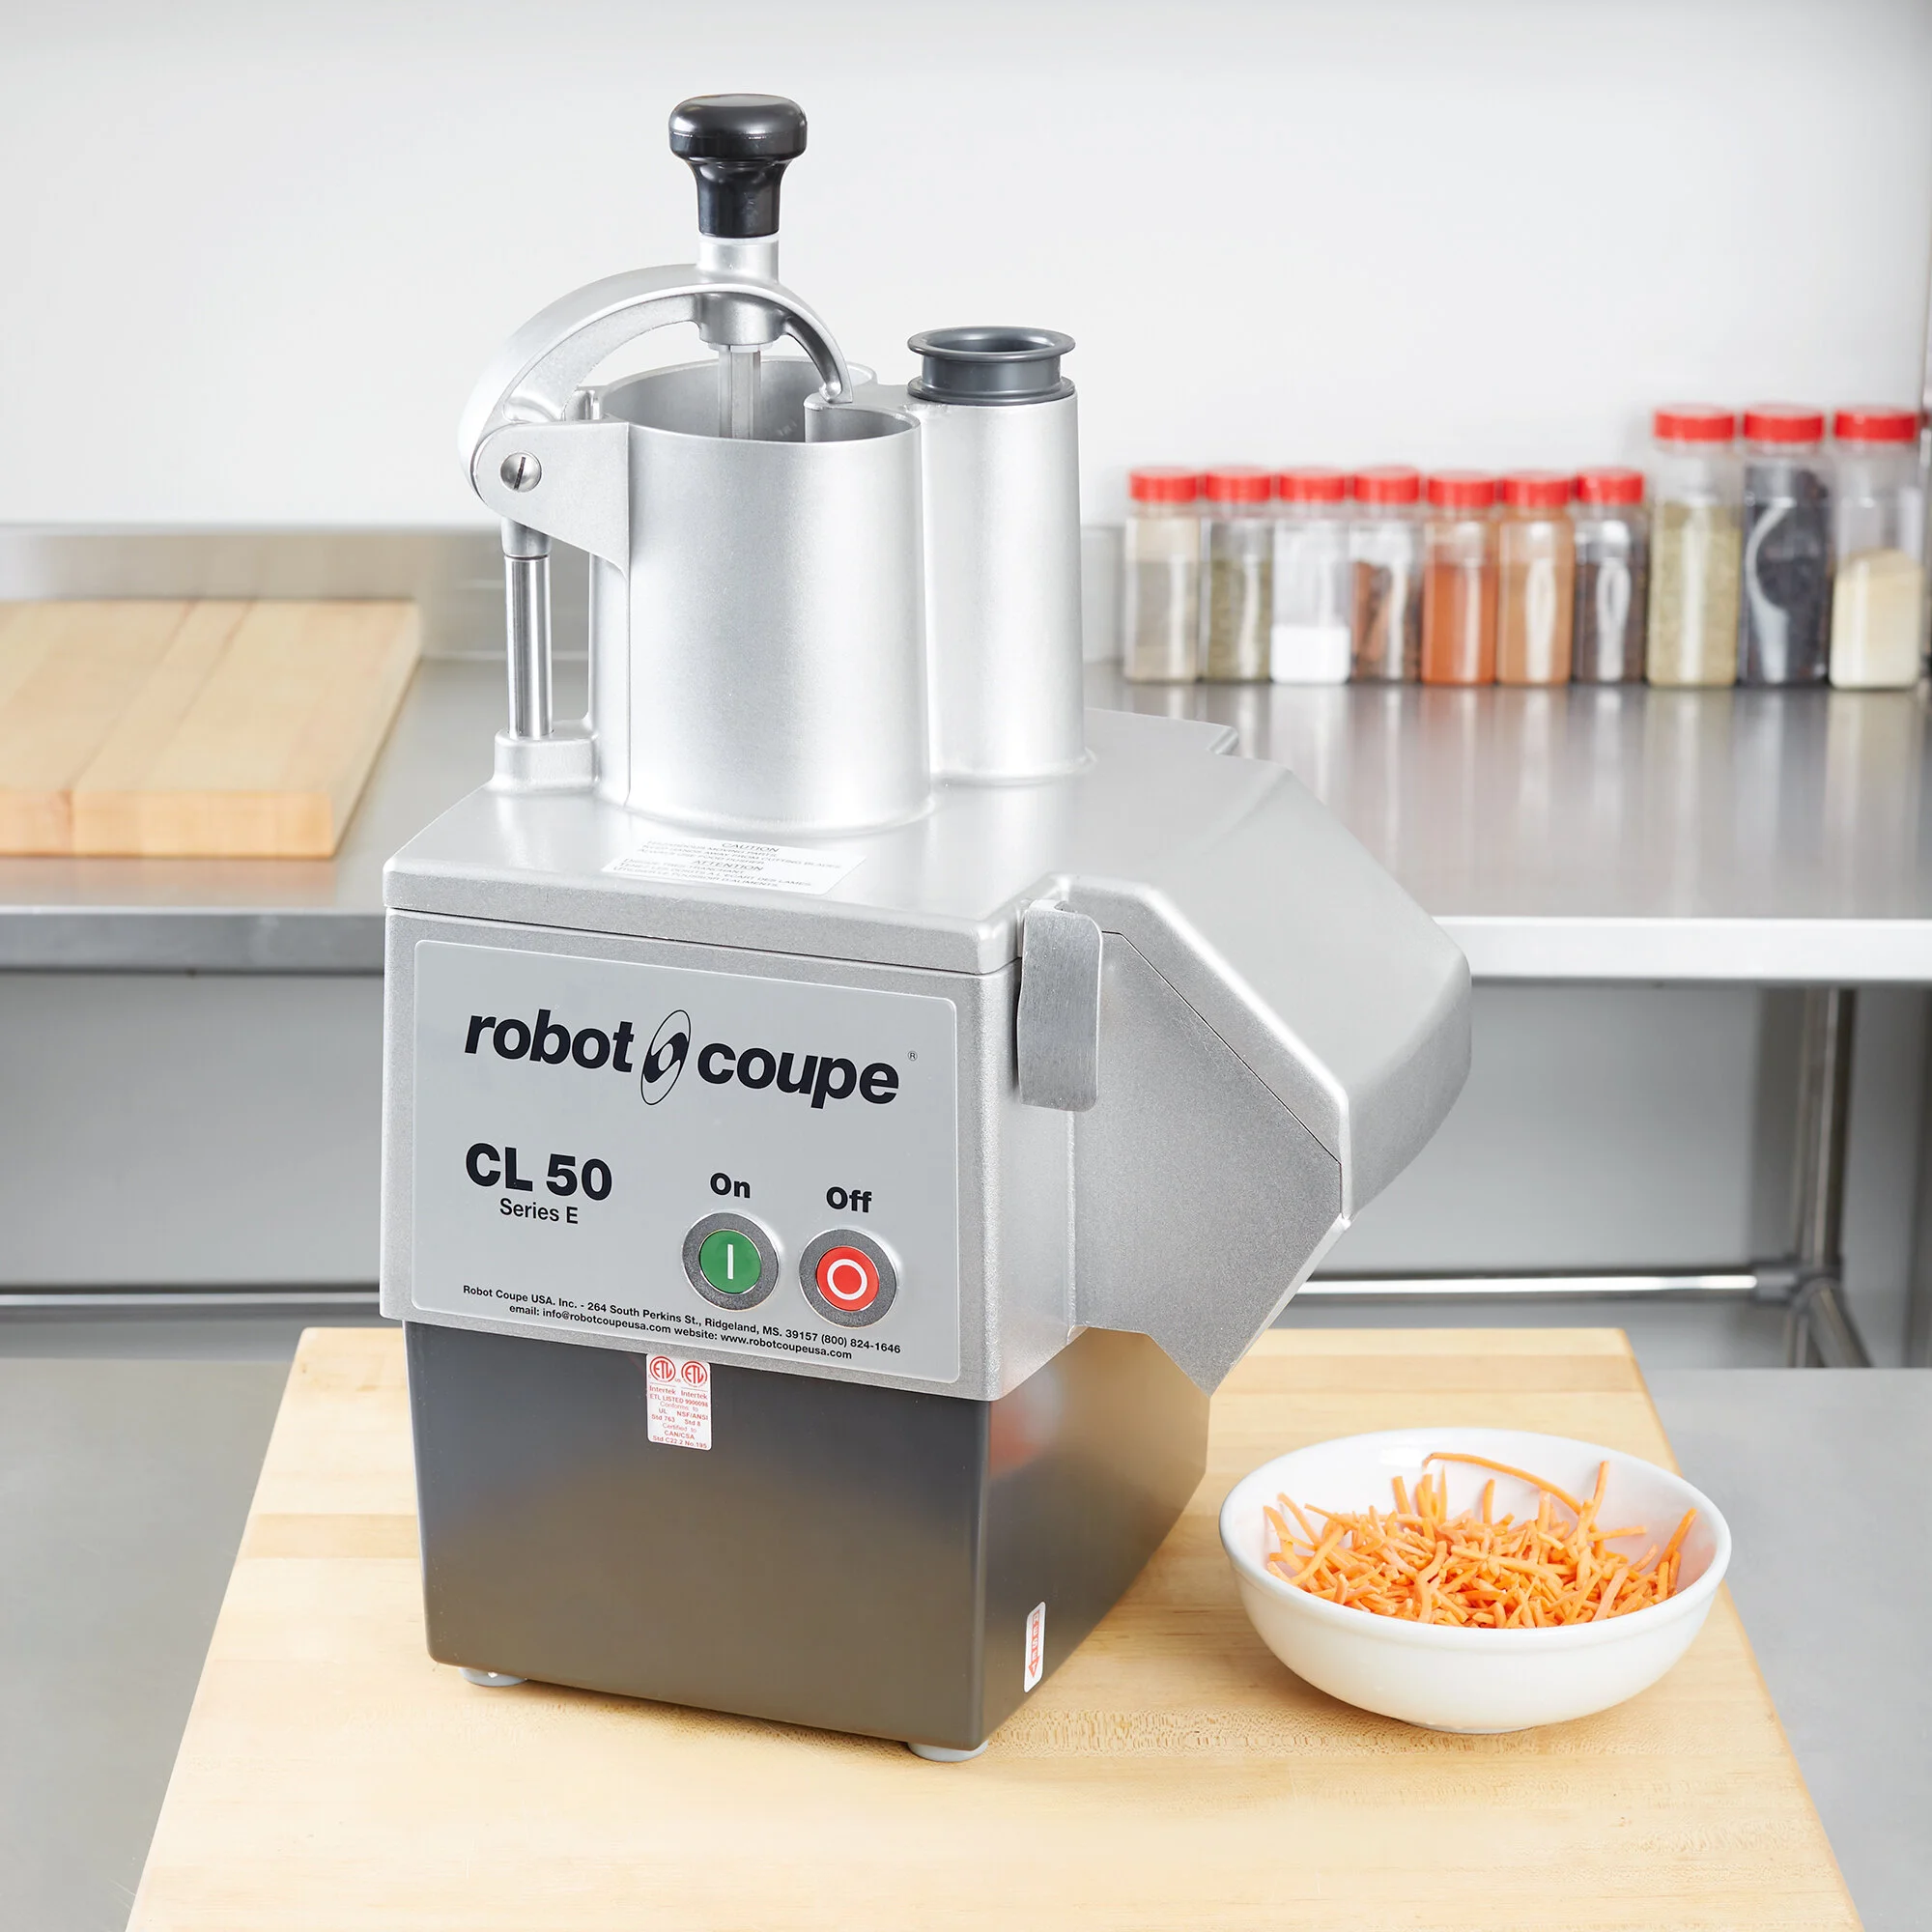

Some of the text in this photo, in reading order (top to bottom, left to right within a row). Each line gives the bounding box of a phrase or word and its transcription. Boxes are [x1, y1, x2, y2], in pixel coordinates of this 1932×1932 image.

[722, 842, 780, 852] CAUTION
[693, 859, 764, 871] ATTENTION
[465, 1009, 634, 1072] robot
[697, 1043, 898, 1109] coupe
[466, 1143, 612, 1201] CL 50
[710, 1172, 751, 1199] On
[499, 1197, 579, 1225] Series E
[826, 1186, 872, 1213] Off
[463, 1284, 493, 1297] Robot
[495, 1289, 528, 1303] Coupe
[530, 1293, 556, 1306] USA.
[558, 1297, 578, 1309] Inc.
[587, 1302, 608, 1313] 264
[610, 1305, 640, 1318] South
[642, 1309, 682, 1323] Perkins
[684, 1314, 702, 1327] St.,
[704, 1317, 760, 1336] Ridgeland,
[762, 1325, 782, 1338] MS.
[784, 1328, 818, 1342] 39157
[820, 1333, 847, 1349] (800)
[849, 1338, 901, 1354] 824-1646
[509, 1305, 852, 1360] email: info@robotcoupeusa.com website: www.robotcoupeusa.com
[649, 1385, 676, 1396] Intertek
[680, 1389, 708, 1400] Intertek
